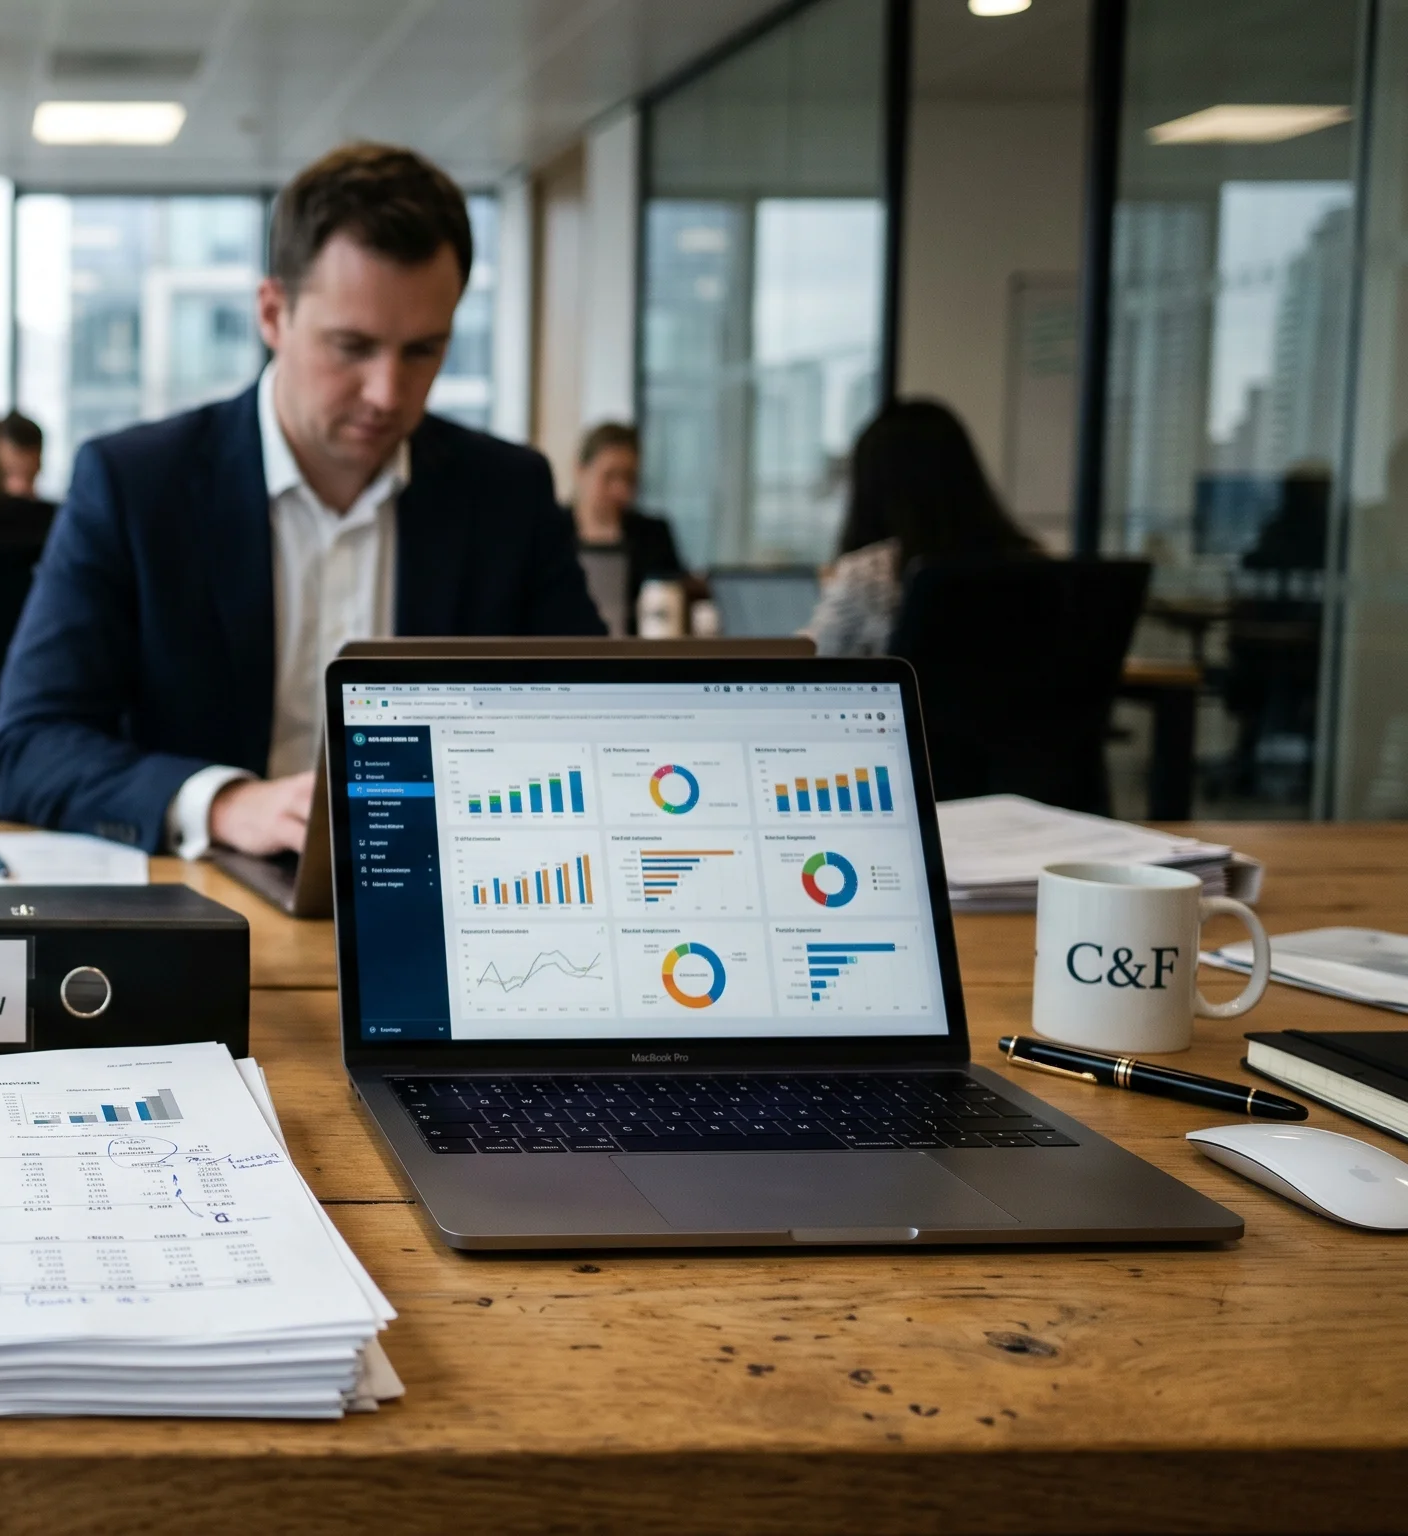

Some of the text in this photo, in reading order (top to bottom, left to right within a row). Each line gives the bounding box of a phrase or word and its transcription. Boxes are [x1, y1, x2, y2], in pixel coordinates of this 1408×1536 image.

[1067, 942, 1180, 990] C&F
[631, 1053, 690, 1062] MacBook Pro
